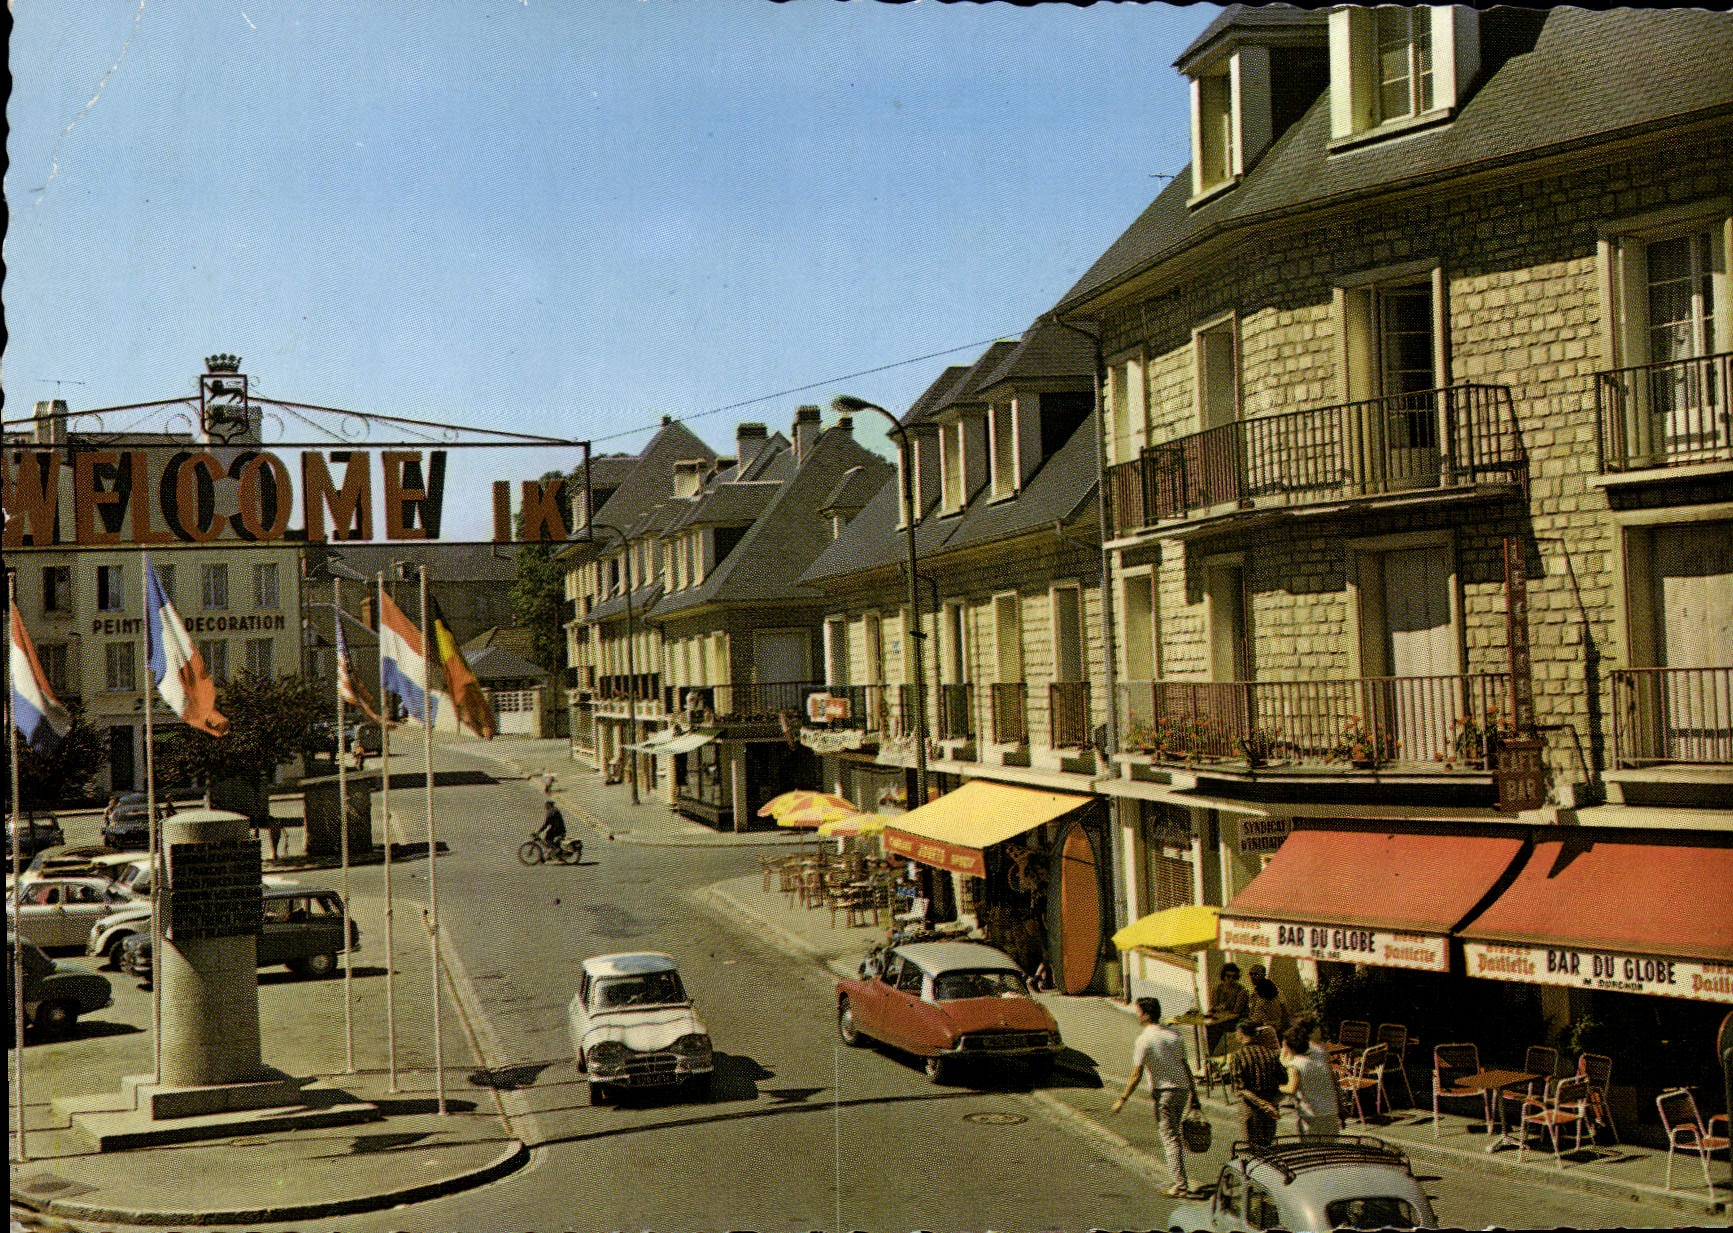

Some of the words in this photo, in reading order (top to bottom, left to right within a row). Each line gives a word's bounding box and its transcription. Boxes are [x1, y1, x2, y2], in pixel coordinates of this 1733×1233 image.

[2, 450, 426, 546] WELCOME
[91, 619, 142, 635] PEINT
[1278, 925, 1305, 947] BAR
[1311, 928, 1329, 949] DU
[1333, 931, 1376, 953] GLOBE
[1546, 950, 1581, 975] BAR
[1593, 955, 1615, 978] DU
[1624, 958, 1677, 985] GLOBE
